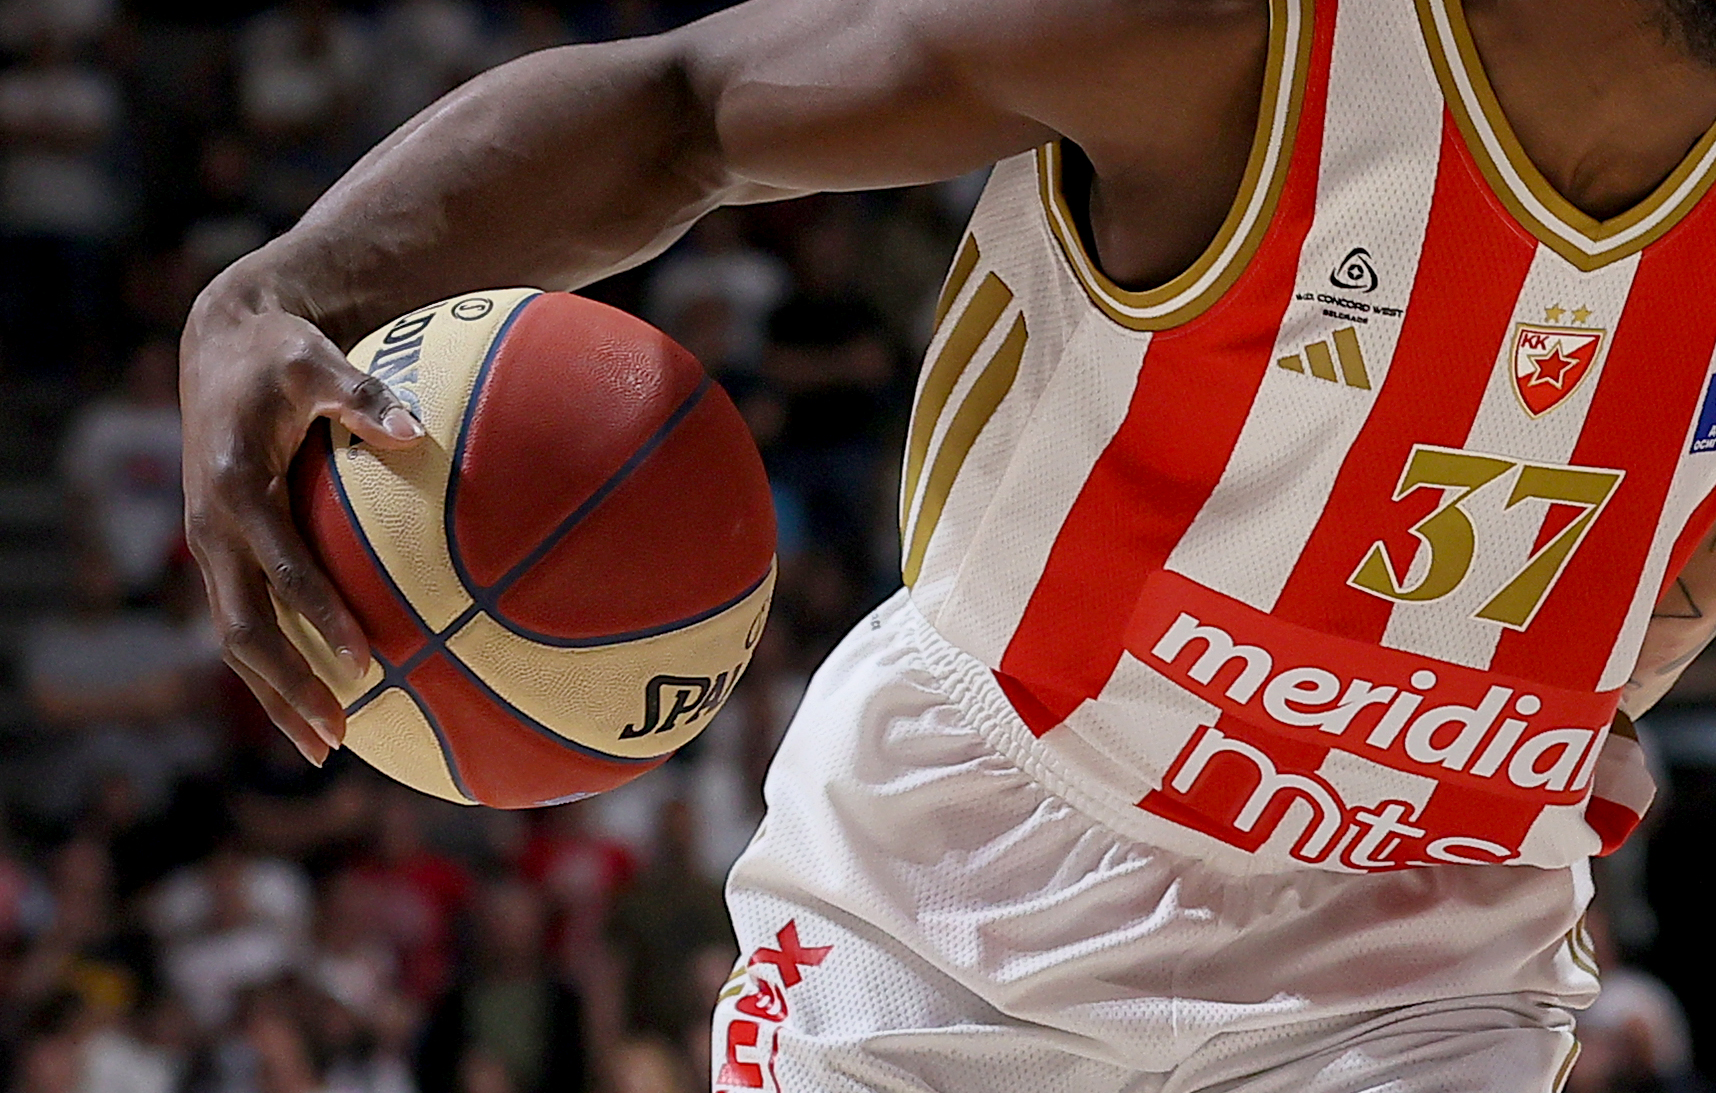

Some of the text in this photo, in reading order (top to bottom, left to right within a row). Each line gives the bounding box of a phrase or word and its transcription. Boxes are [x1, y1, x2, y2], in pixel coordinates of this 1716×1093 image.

[1317, 294, 1371, 312] CONCORD
[1372, 305, 1404, 318] WEST
[1521, 333, 1550, 351] KK
[1347, 444, 1625, 633] 37
